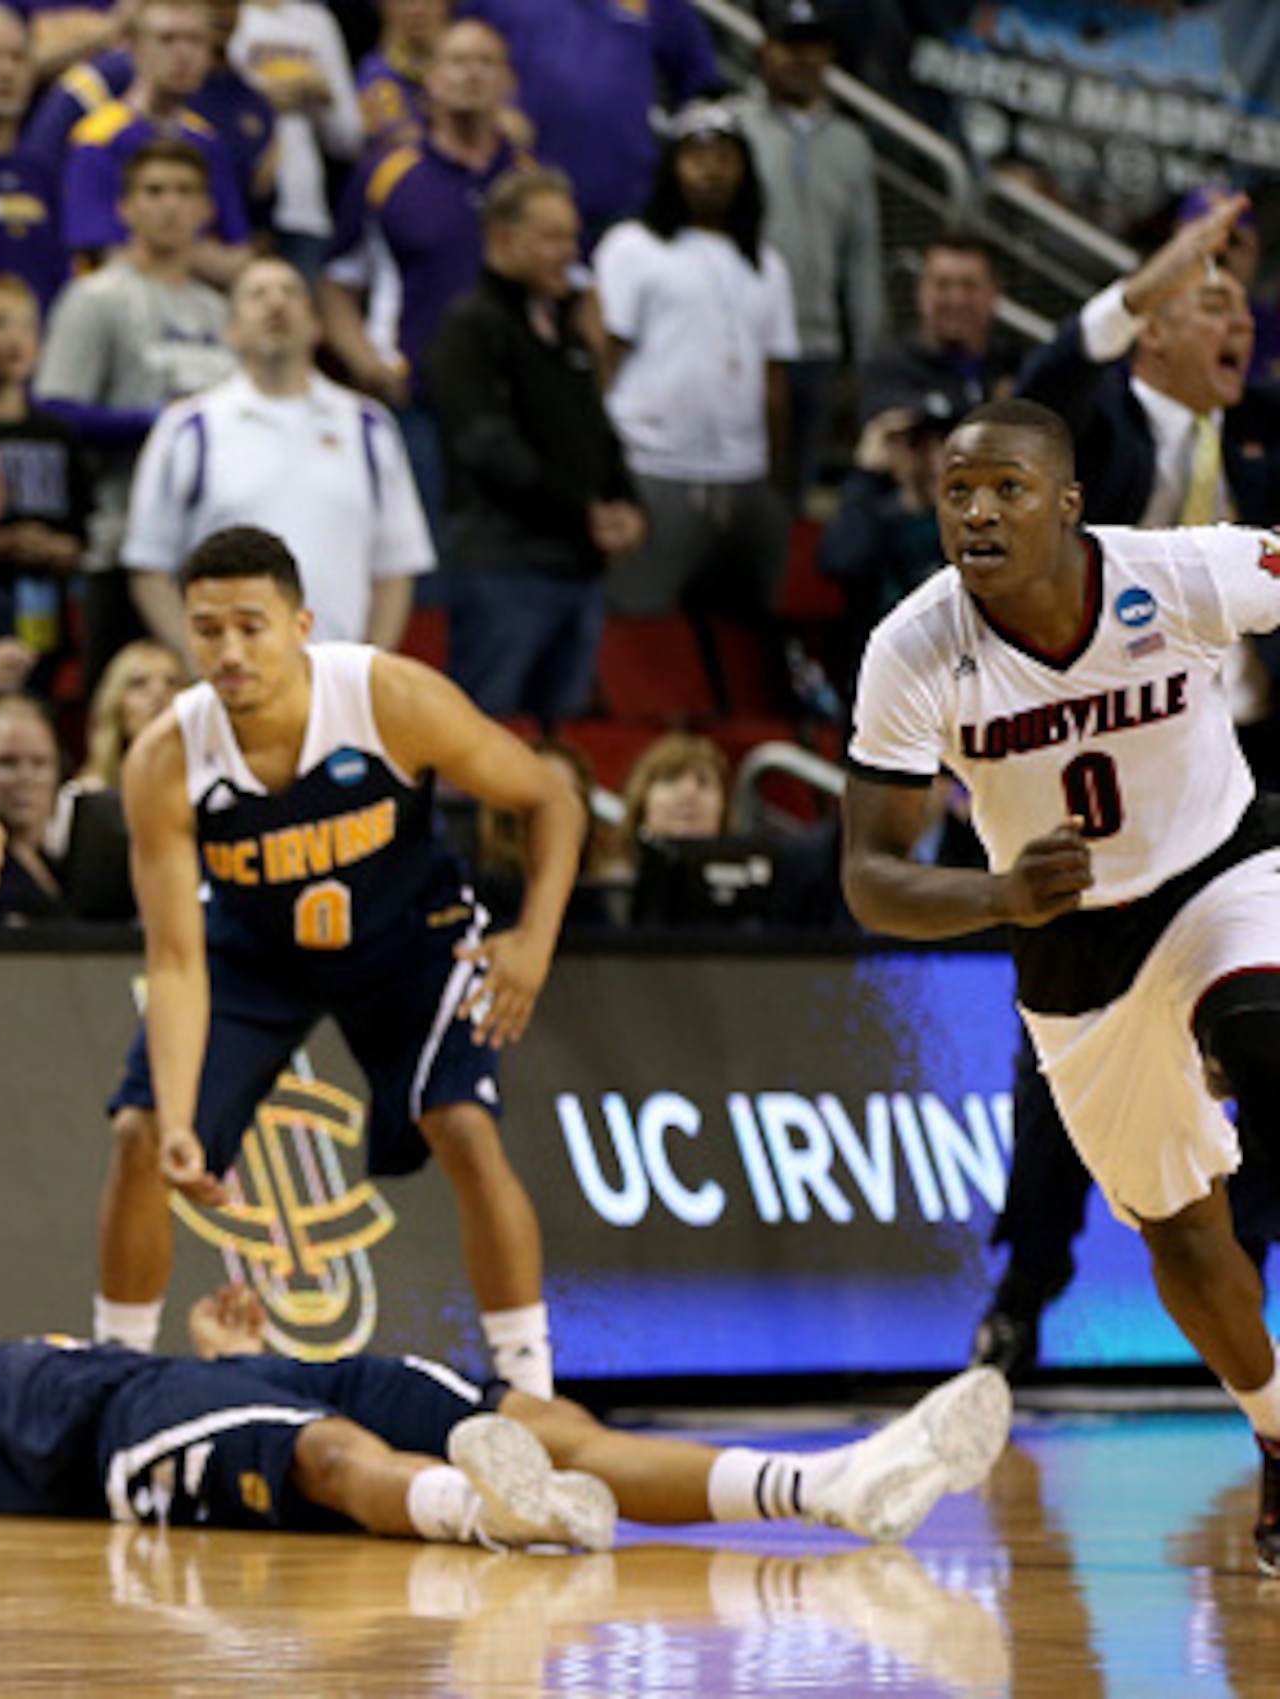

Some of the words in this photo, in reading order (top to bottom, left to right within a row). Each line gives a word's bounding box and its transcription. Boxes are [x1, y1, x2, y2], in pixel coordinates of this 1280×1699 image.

[961, 671, 1188, 760] LOUISVILLE
[1062, 750, 1125, 840] 0
[262, 798, 397, 884] IRVINE
[294, 878, 353, 950] 0
[556, 1091, 726, 1227] UC
